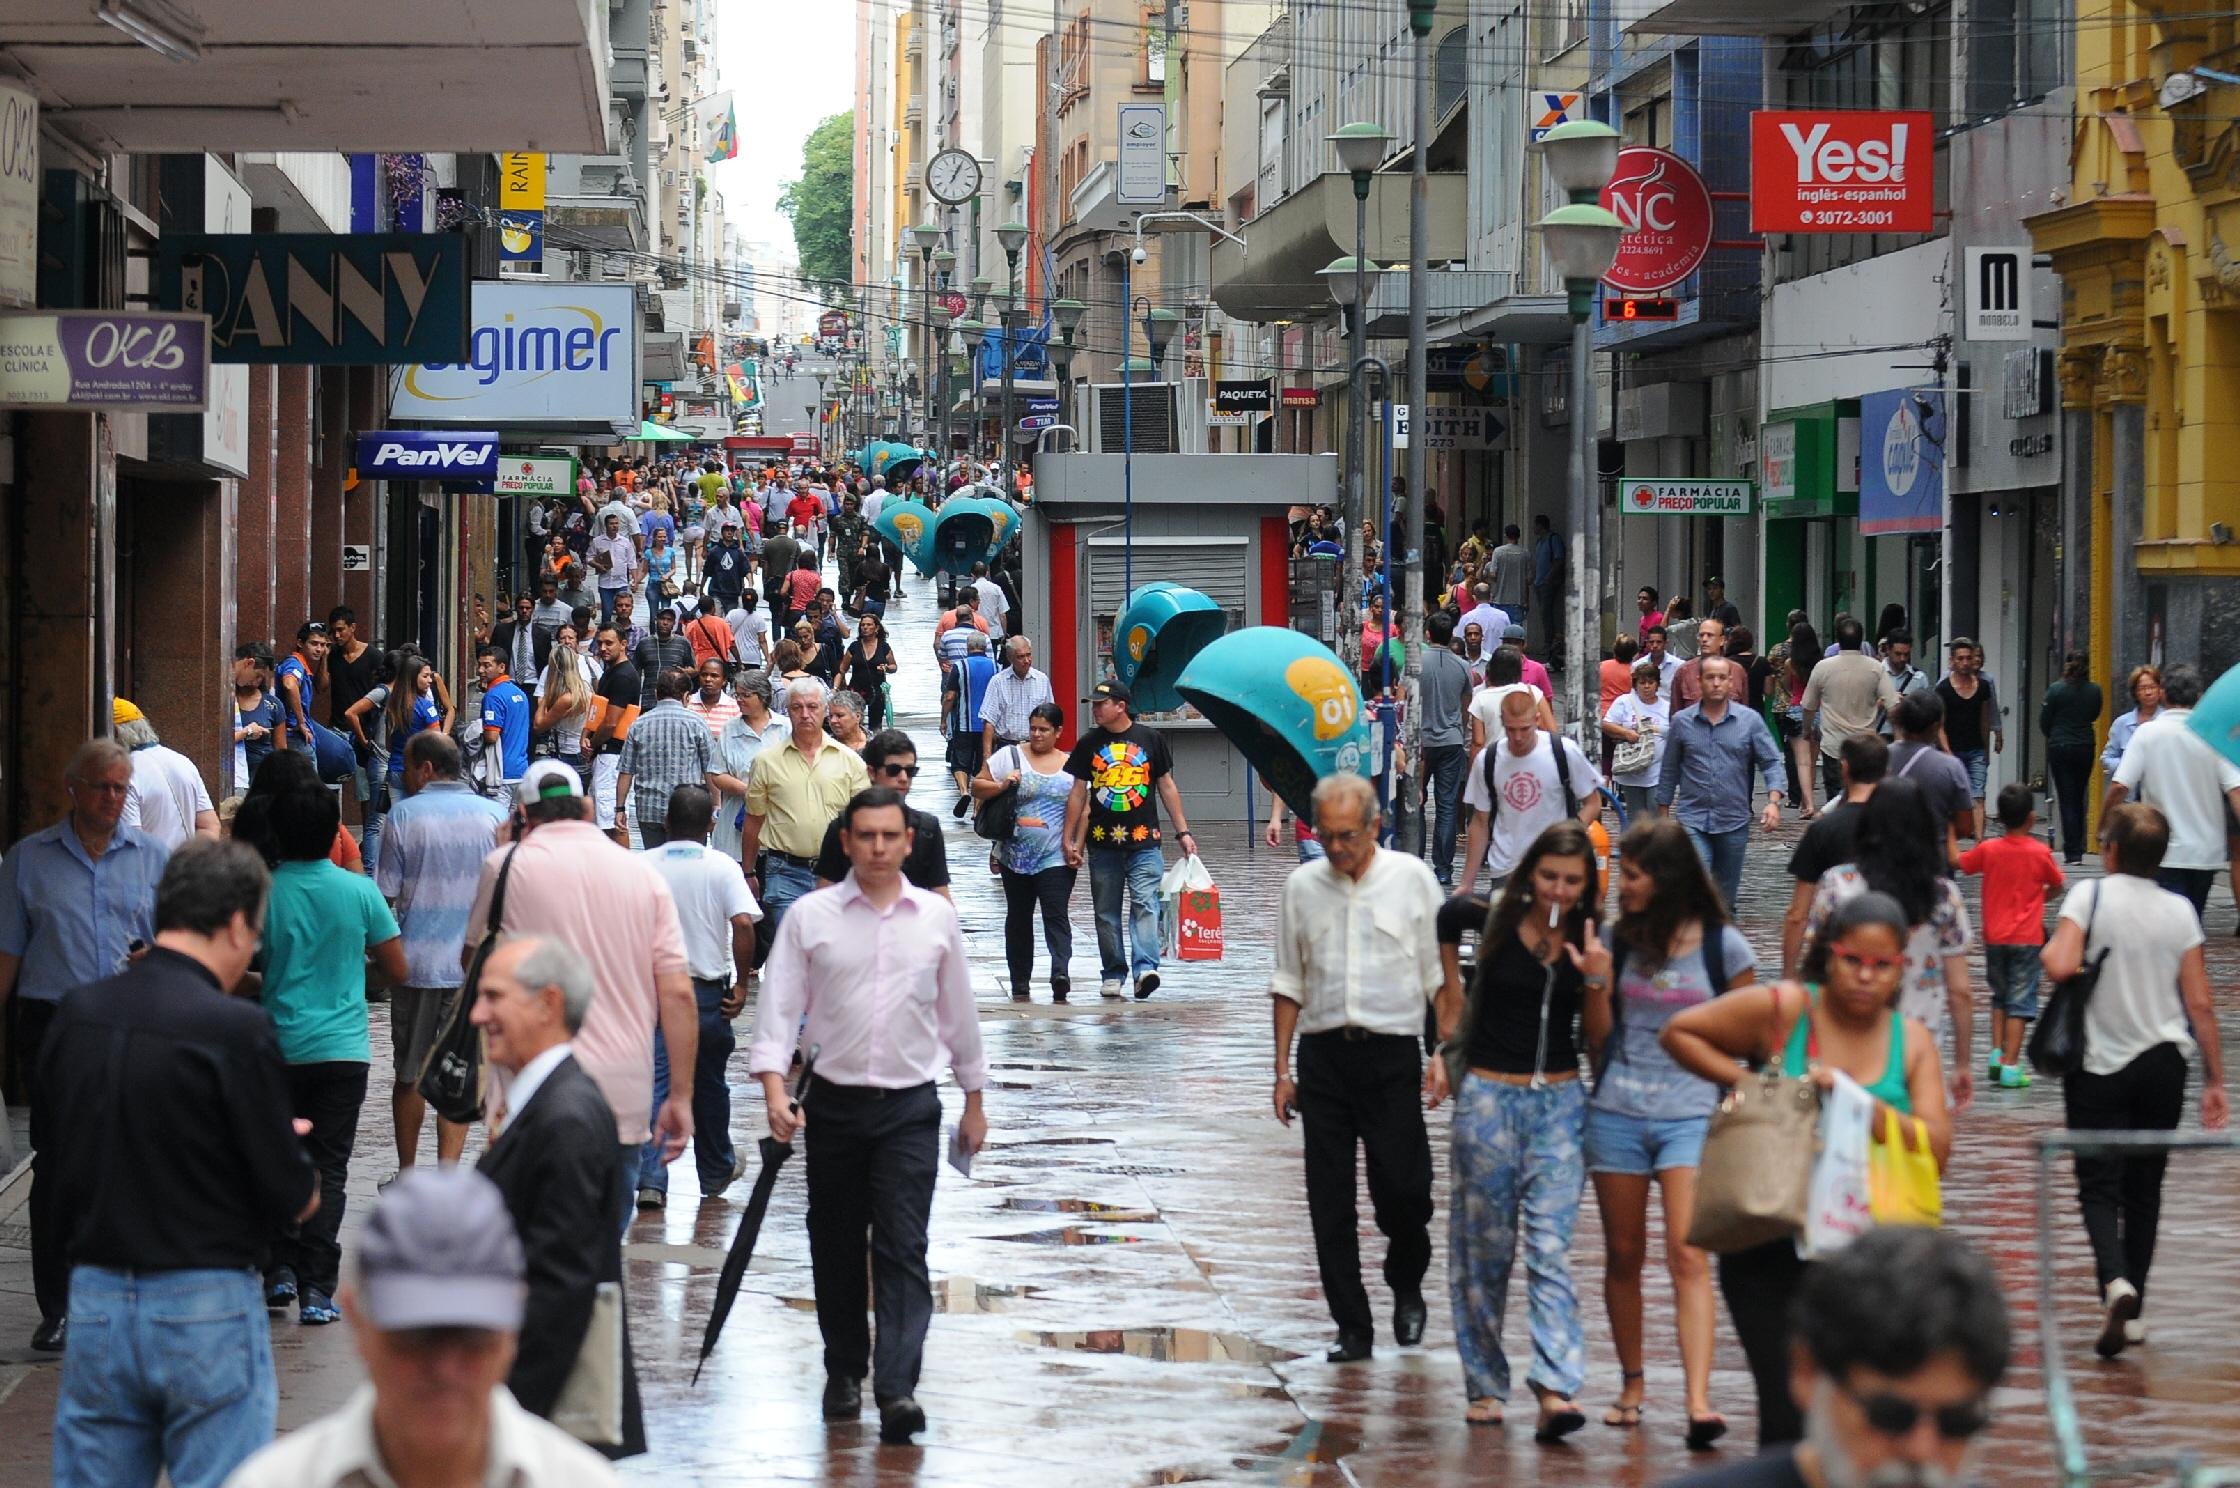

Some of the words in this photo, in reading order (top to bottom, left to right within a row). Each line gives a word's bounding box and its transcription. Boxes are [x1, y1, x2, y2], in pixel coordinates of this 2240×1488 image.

[1779, 123, 1908, 182] Yes!
[1797, 188, 1906, 204] inglês-espanhol
[1611, 192, 1676, 231] NC
[1815, 210, 1893, 225] 3072-3001
[1618, 230, 1674, 244] stética
[0, 345, 44, 356] ESCOLA
[48, 345, 54, 356] E
[424, 313, 621, 386] gimer
[4, 360, 49, 373] CLÍNICA
[1219, 389, 1268, 400] PAQUETÁ
[1397, 407, 1480, 417] GLERIA
[372, 443, 493, 468] PanVel
[524, 481, 554, 491] POPULAR
[1658, 484, 1741, 497] FARMÁCIA
[1321, 683, 1352, 725] oi
